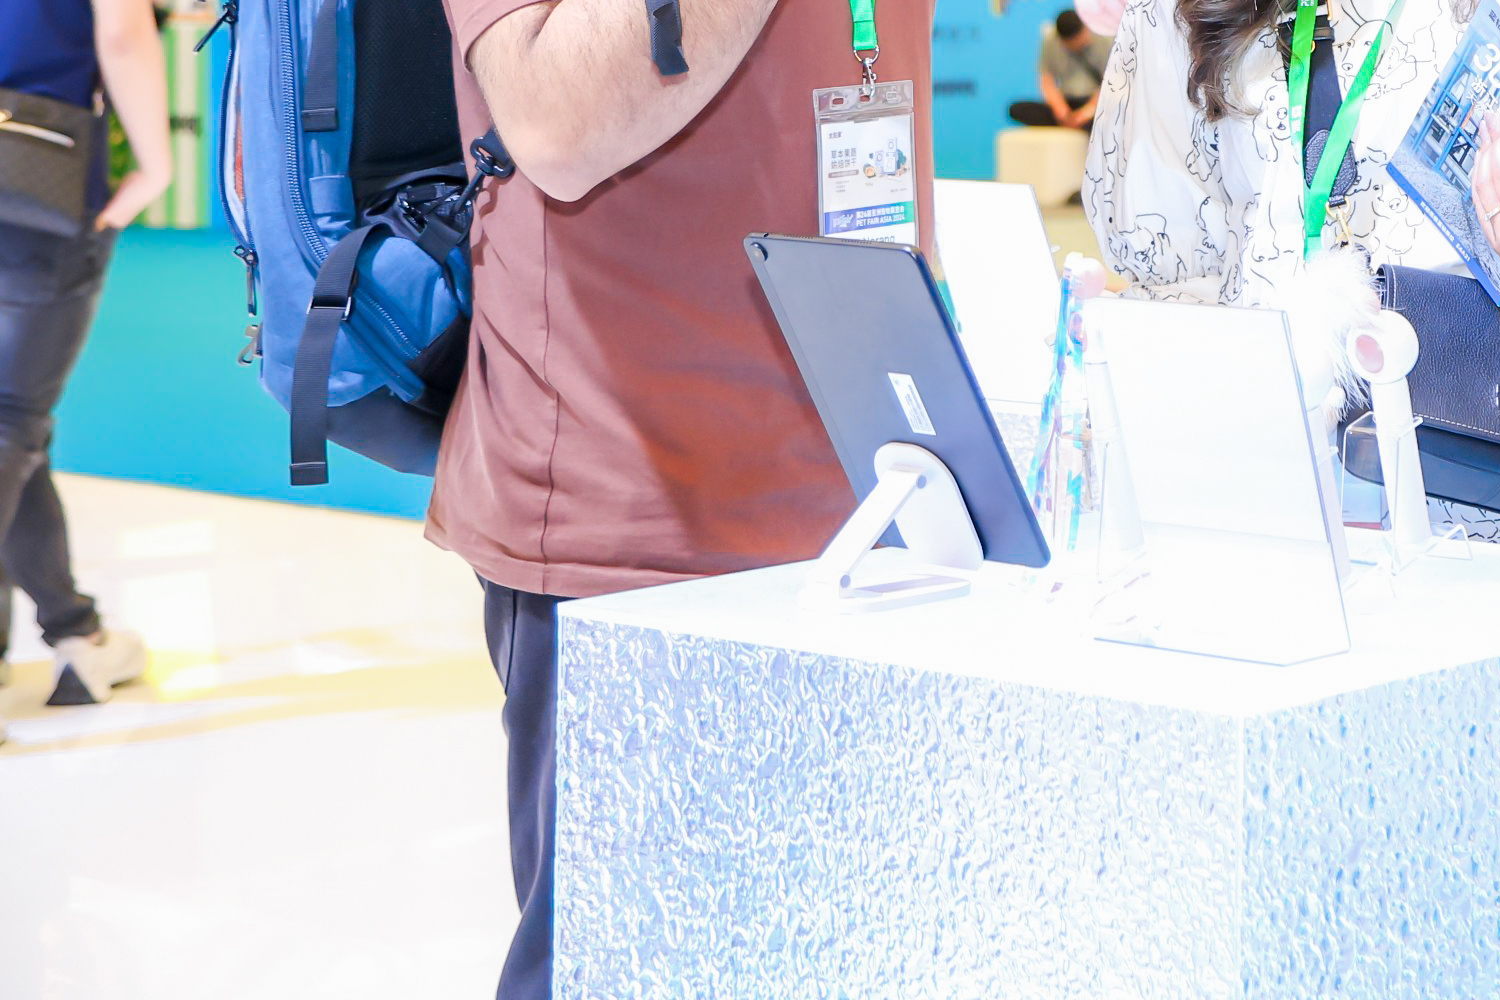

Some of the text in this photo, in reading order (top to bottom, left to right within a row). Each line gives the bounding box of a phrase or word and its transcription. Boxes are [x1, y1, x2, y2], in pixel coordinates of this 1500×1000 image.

[856, 218, 866, 227] PET
[867, 216, 880, 225] FAIR
[880, 215, 892, 224] ASIA
